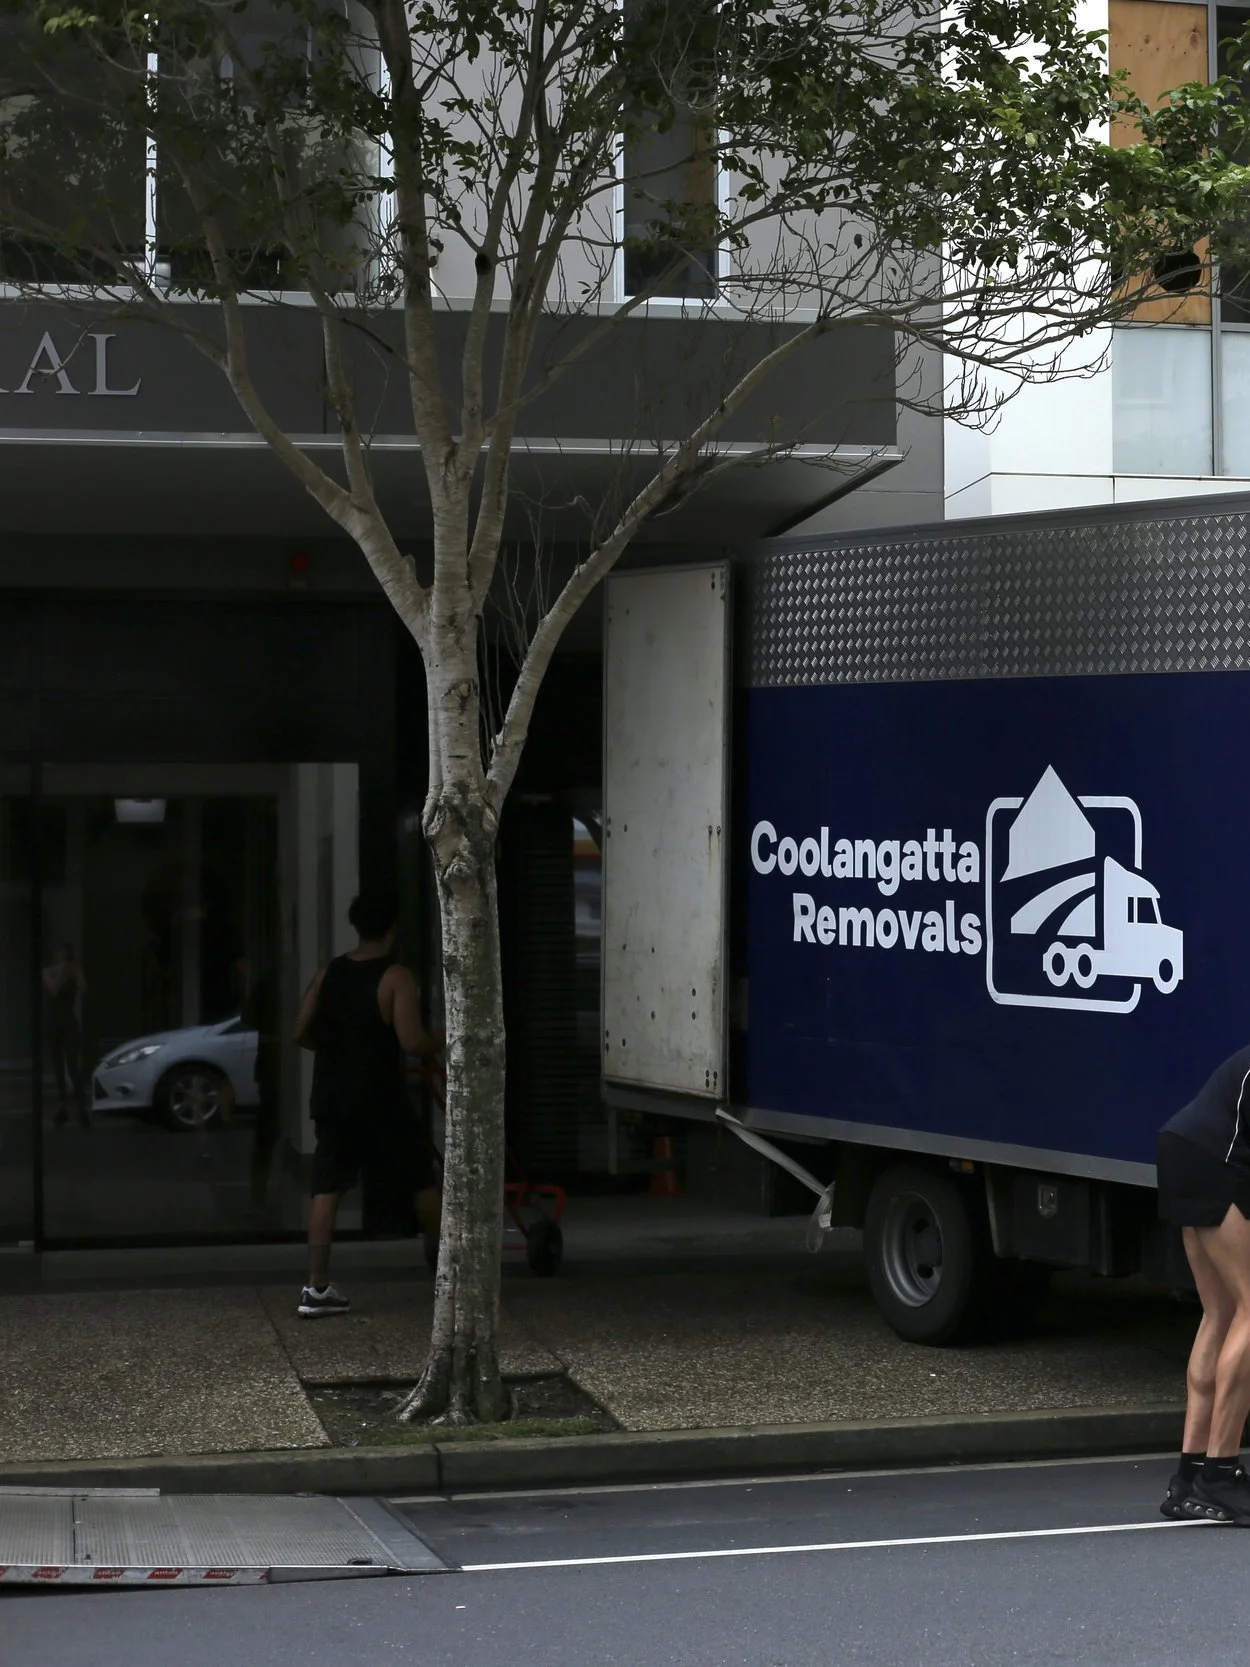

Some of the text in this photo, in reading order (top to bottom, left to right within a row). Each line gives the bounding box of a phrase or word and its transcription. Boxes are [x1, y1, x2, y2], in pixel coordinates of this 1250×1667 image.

[0, 331, 141, 395] AL
[751, 820, 979, 896] Coolangatta
[793, 893, 982, 955] Removals
